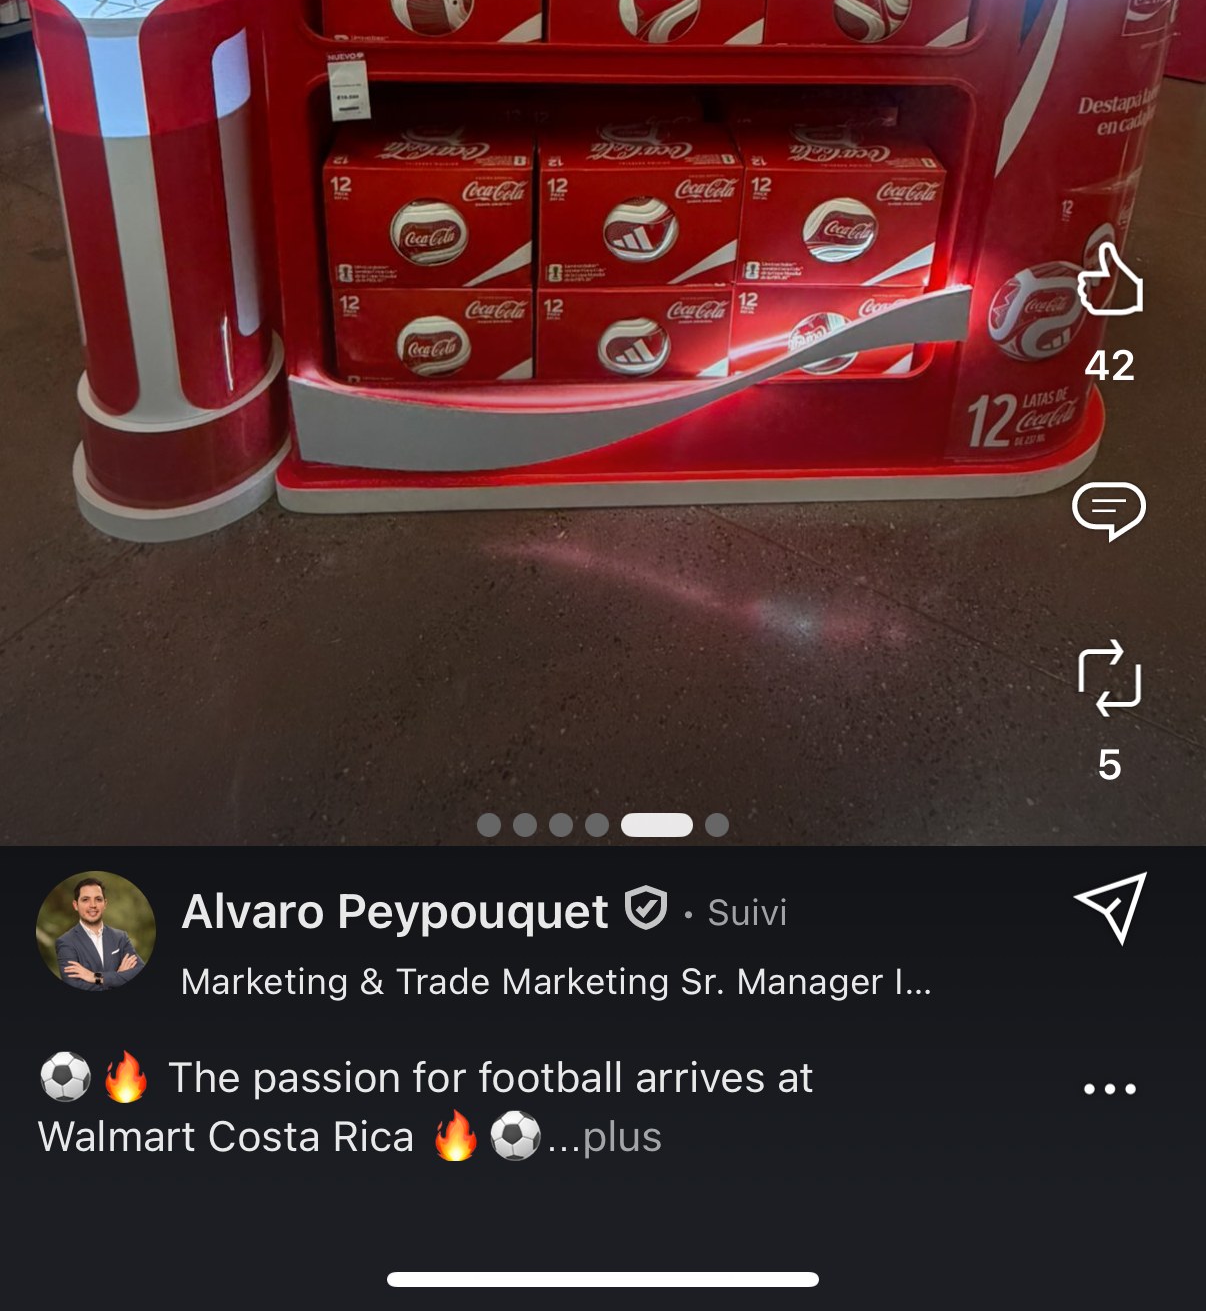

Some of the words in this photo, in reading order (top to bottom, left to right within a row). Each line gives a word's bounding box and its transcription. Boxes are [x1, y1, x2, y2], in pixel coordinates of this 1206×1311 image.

[327, 52, 356, 61] NUEVO
[1097, 120, 1118, 136] en
[330, 176, 352, 192] 12
[462, 180, 528, 202] Coca-Cola
[547, 178, 568, 193] 12
[675, 178, 740, 198] Coca-Cola
[751, 177, 771, 192] 12
[876, 181, 941, 202] Coca-Cola
[1062, 199, 1074, 215] 12
[405, 226, 456, 247] Coca-Cola
[823, 219, 875, 240] Coca-Cola
[340, 295, 360, 310] 12
[544, 299, 564, 313] 12
[738, 292, 758, 307] 12
[465, 300, 528, 319] Coca-Cola
[667, 300, 730, 319] Coca-Cola
[408, 337, 457, 357] Coca-Cola
[1022, 390, 1055, 408] LATAS
[1055, 386, 1069, 402] DE
[967, 393, 1018, 447] 12
[1016, 396, 1079, 433] Coca-Cola
